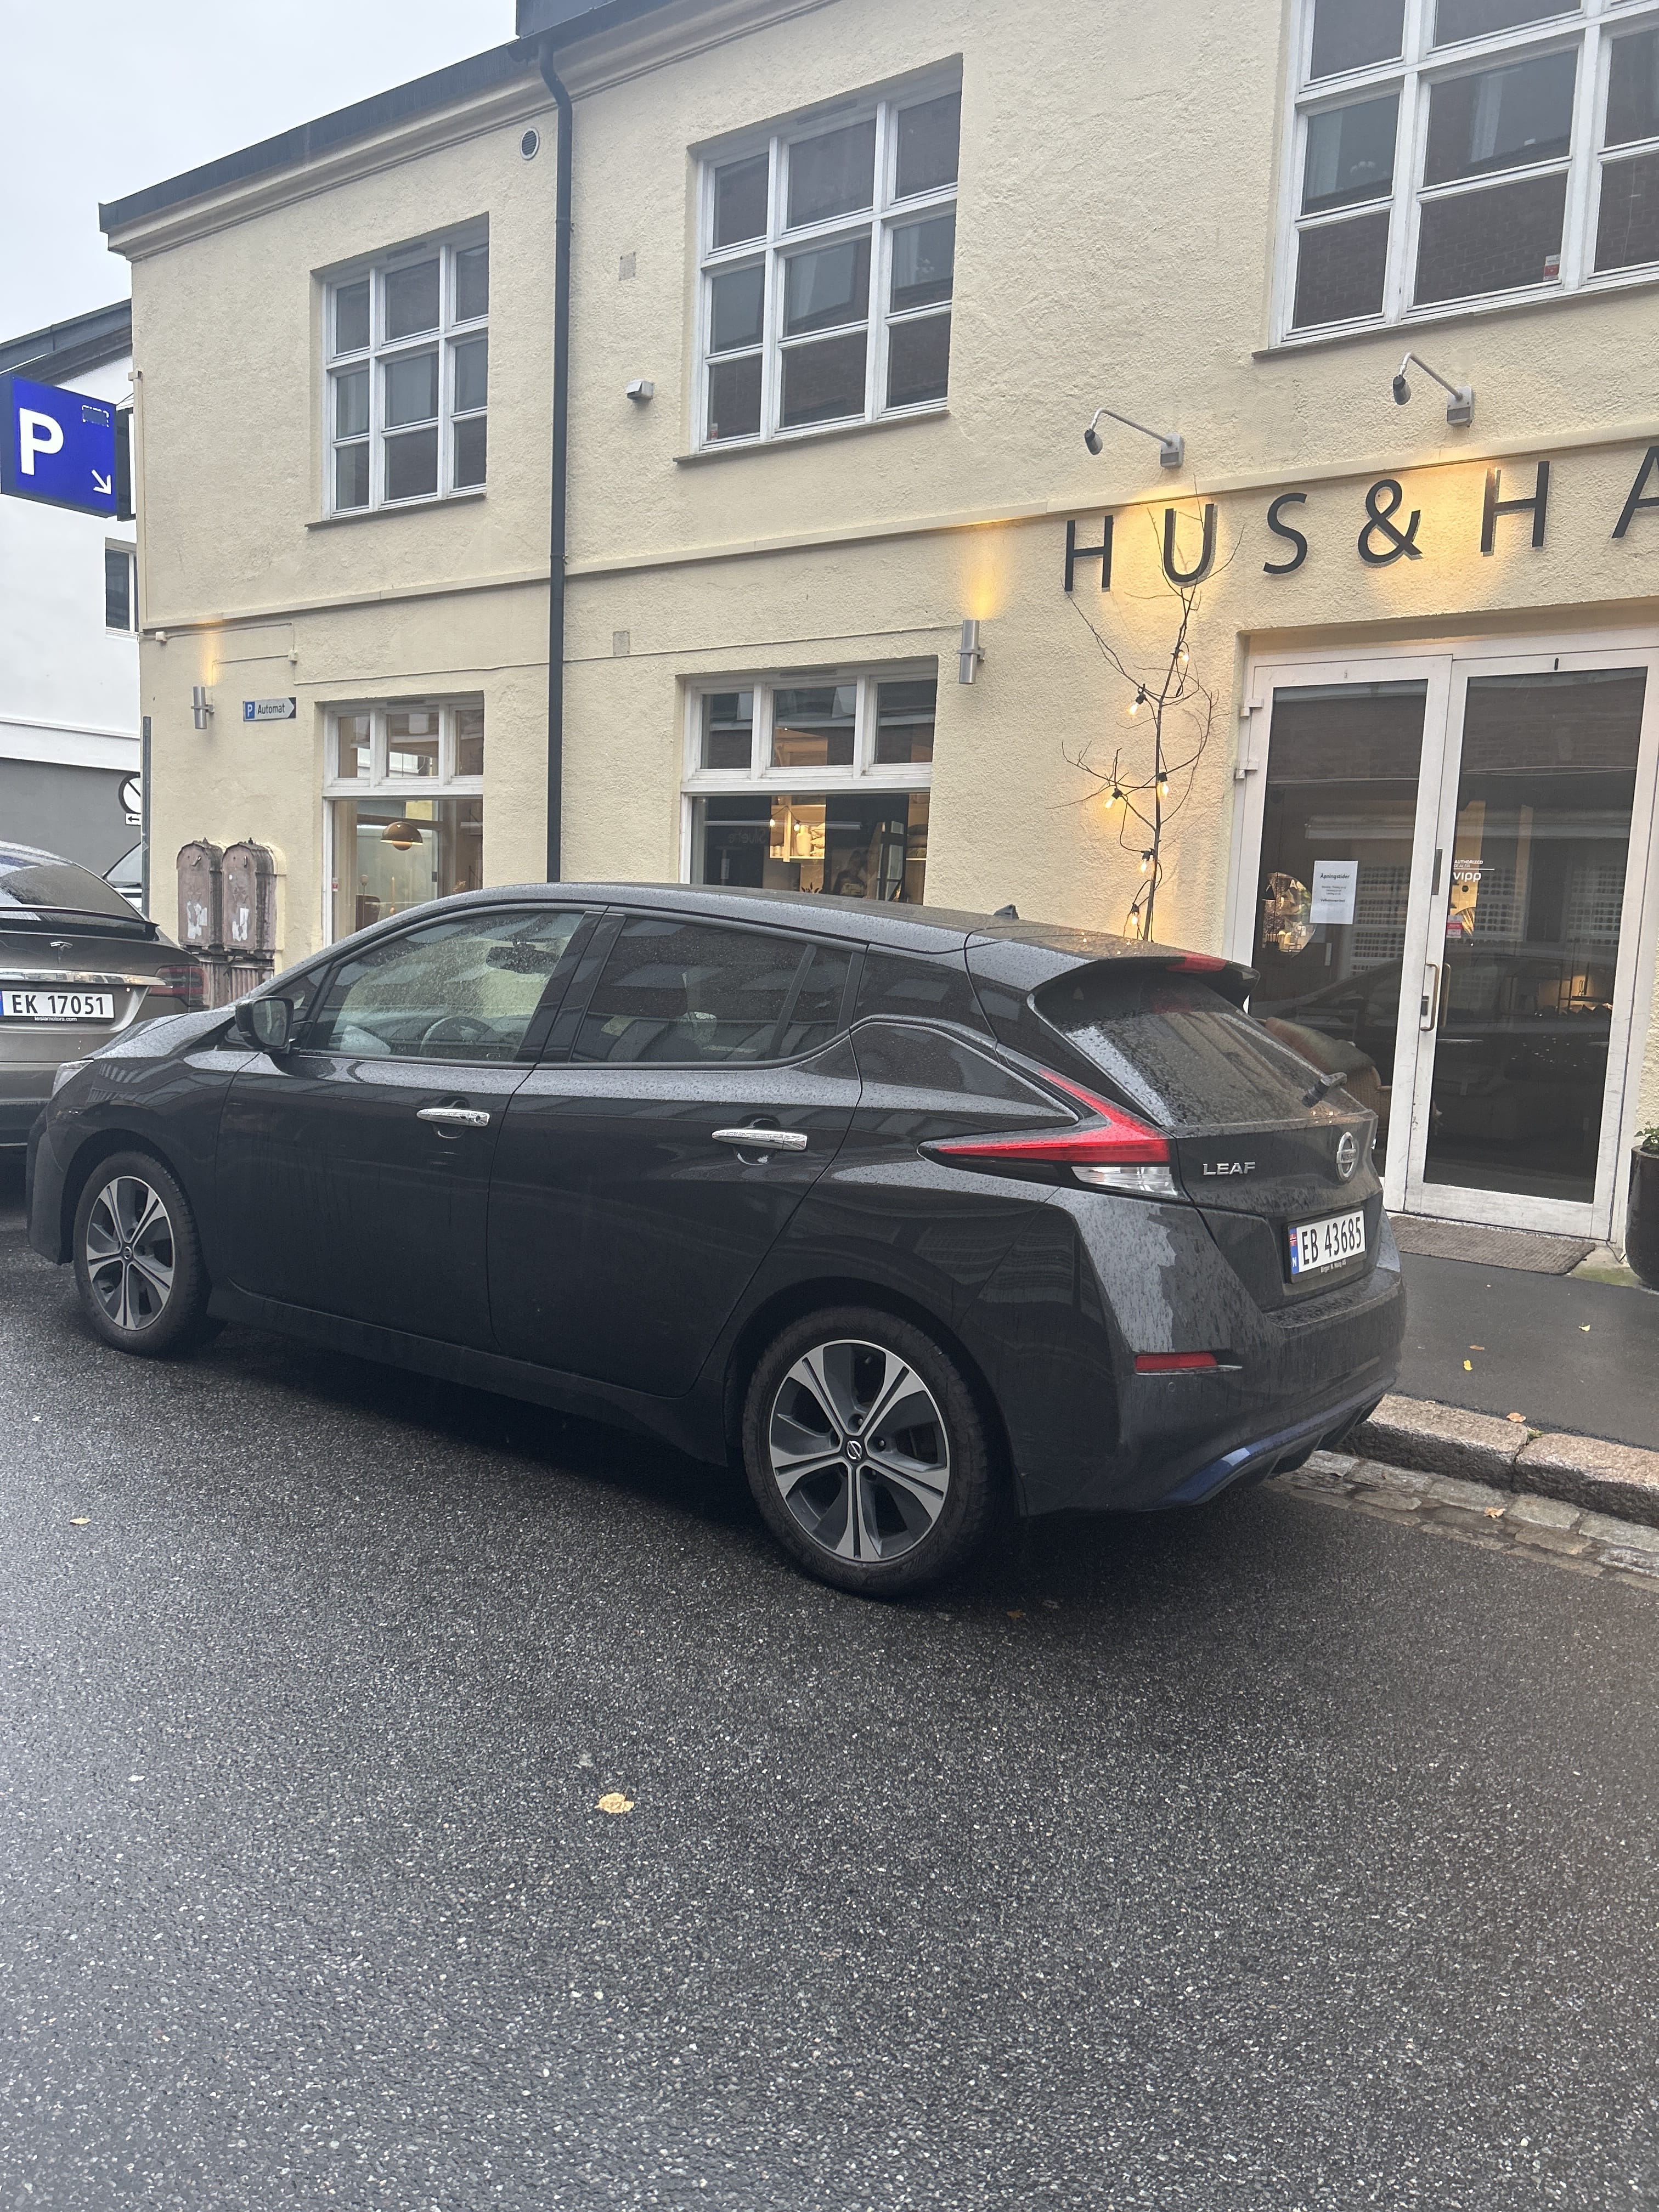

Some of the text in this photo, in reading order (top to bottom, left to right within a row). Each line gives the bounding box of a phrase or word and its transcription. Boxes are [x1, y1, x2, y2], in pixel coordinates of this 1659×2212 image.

[20, 408, 64, 476] P
[1064, 492, 1308, 592] HUS
[1358, 478, 1423, 564] &
[247, 703, 285, 718] P Automat
[1453, 872, 1482, 883] vipp
[12, 995, 104, 1015] EK 17051
[1203, 1161, 1256, 1175] LEAF
[1301, 1216, 1361, 1265] EB 43685
[1292, 1256, 1297, 1267] N
